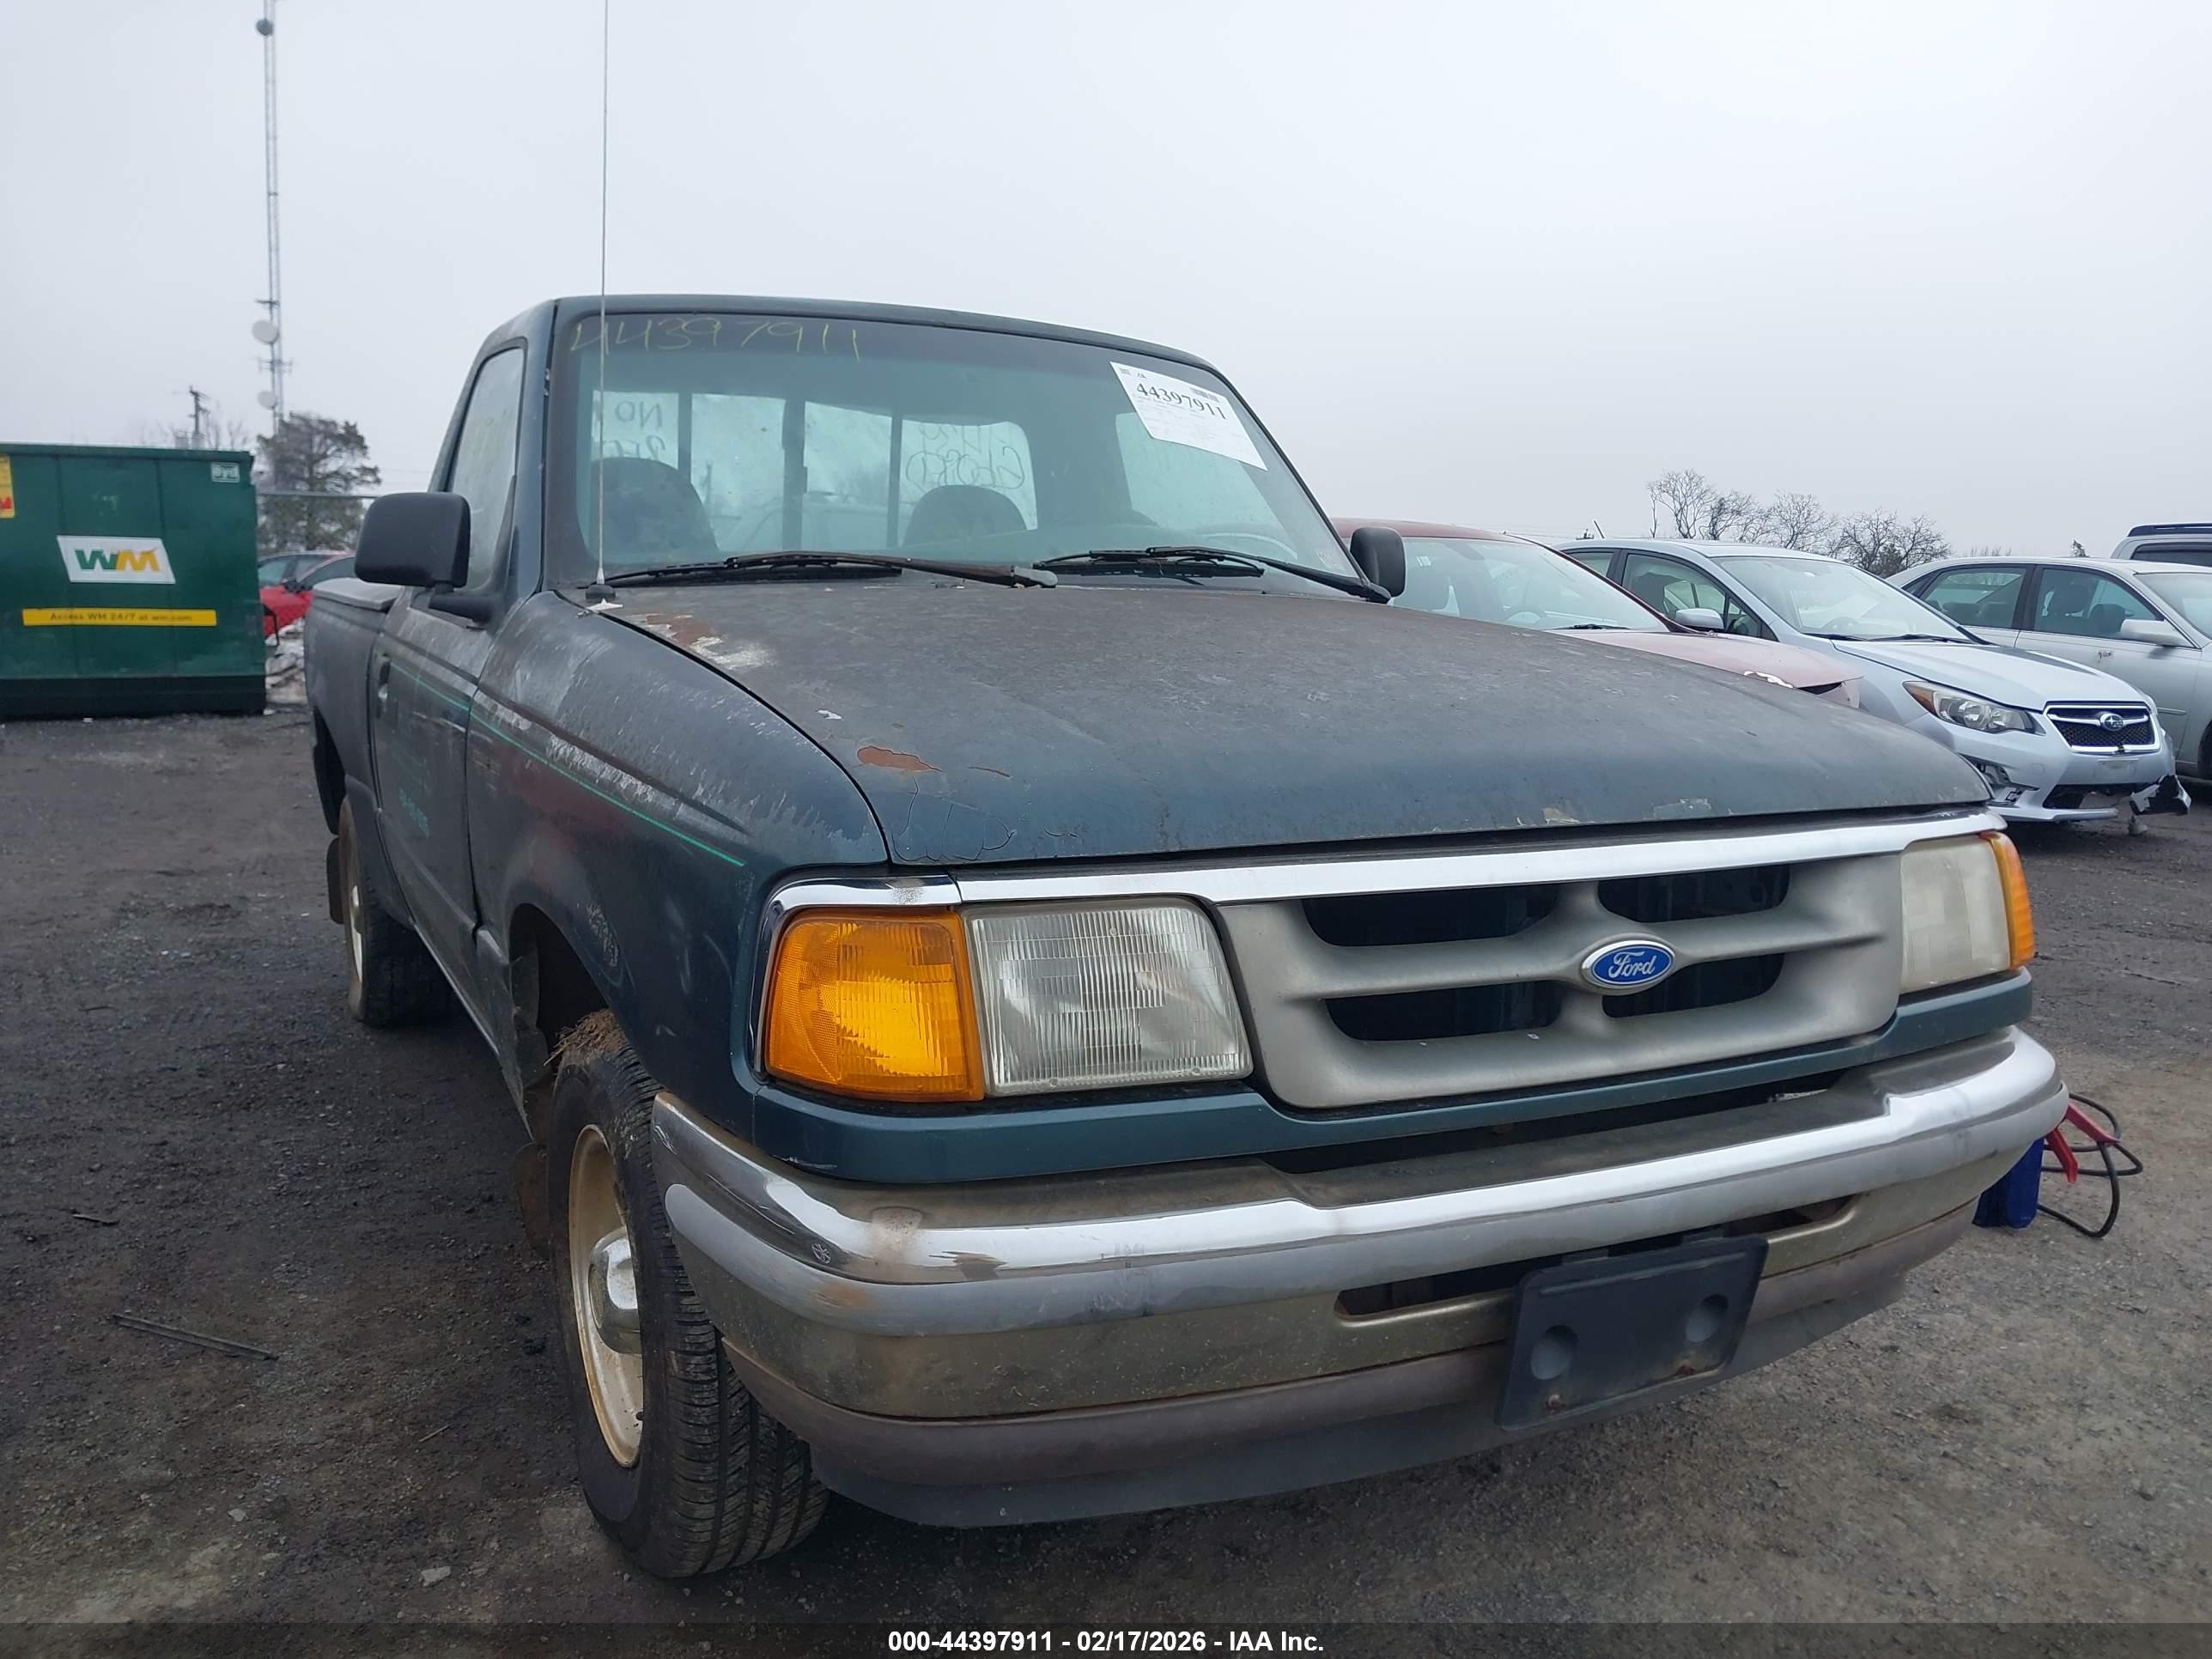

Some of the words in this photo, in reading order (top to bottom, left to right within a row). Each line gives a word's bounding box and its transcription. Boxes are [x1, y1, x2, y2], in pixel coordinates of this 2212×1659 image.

[570, 317, 860, 362] 44397911
[1136, 382, 1226, 420] 44397911
[75, 549, 161, 571] WM
[110, 612, 136, 621] 24/7
[1607, 951, 1658, 978] Ford
